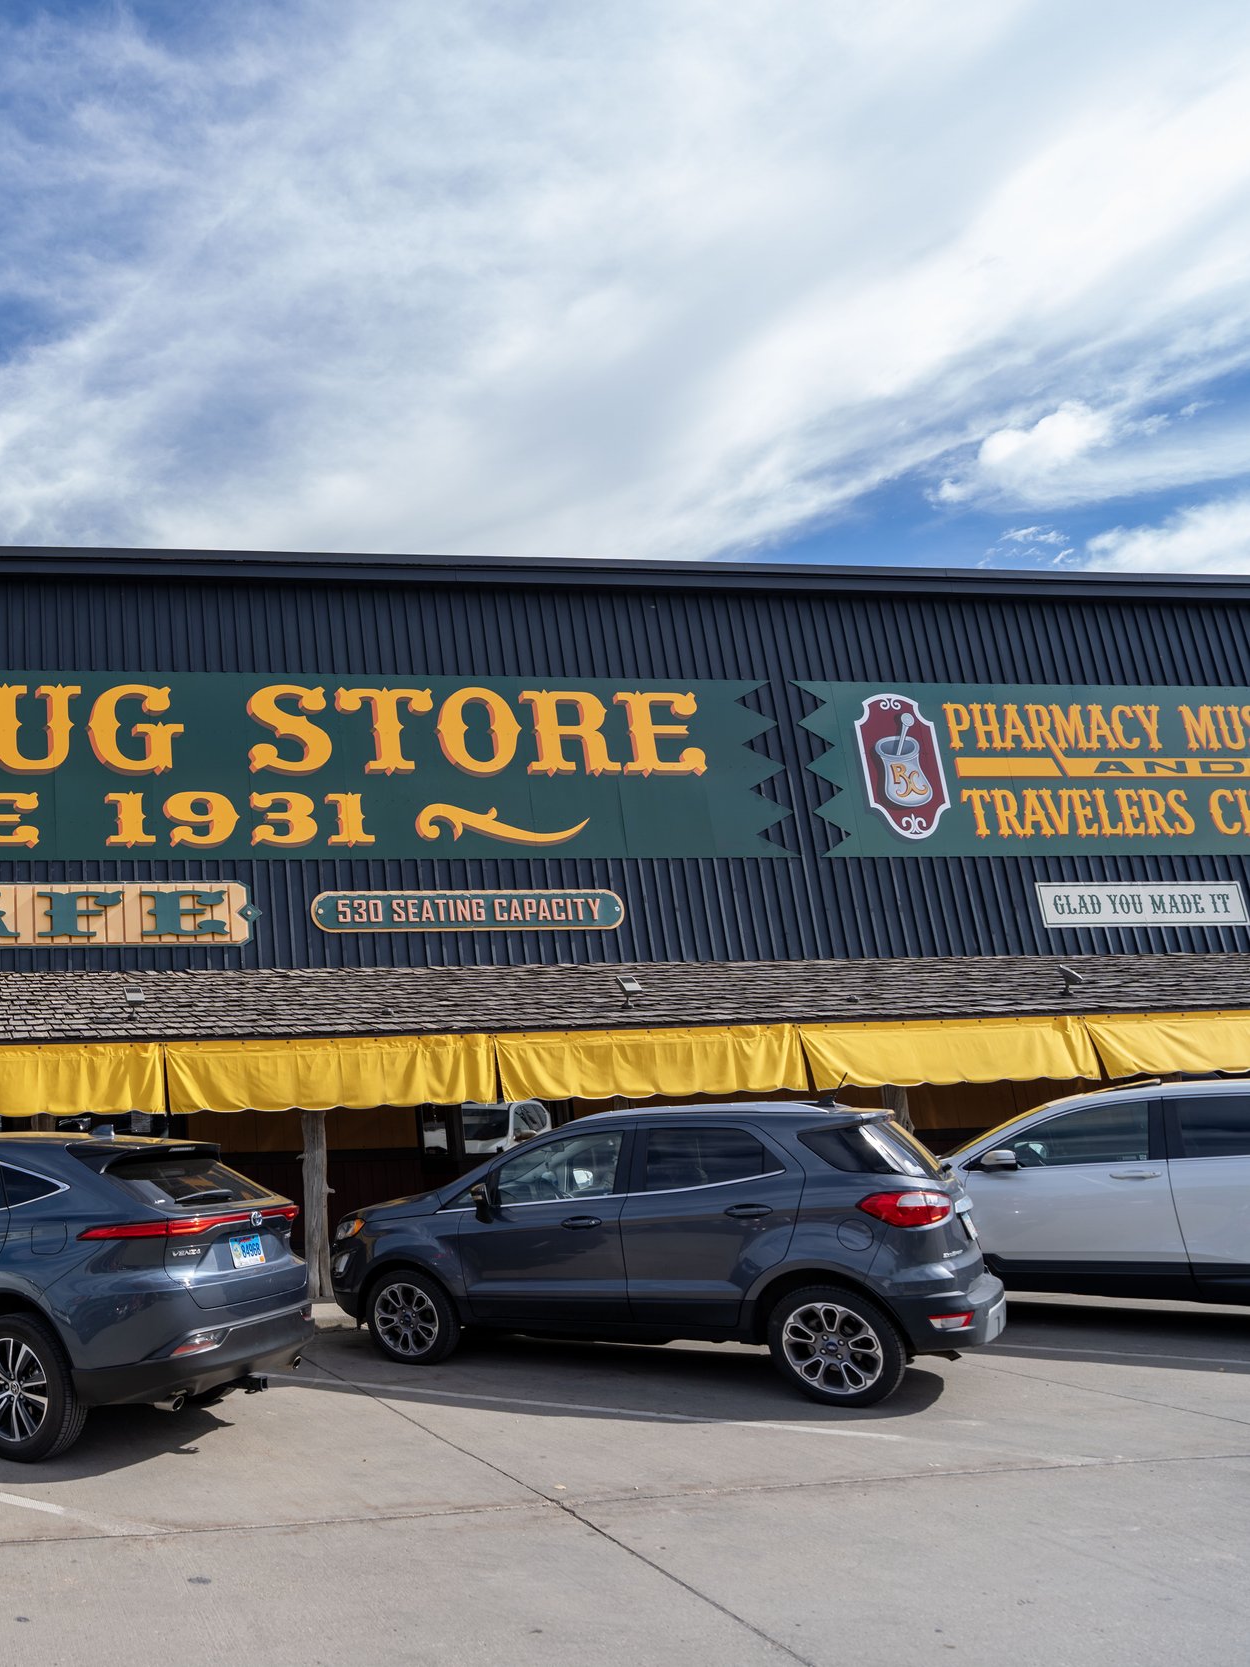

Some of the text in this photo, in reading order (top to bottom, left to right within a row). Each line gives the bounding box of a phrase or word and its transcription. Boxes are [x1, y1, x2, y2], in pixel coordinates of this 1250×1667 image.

[247, 685, 708, 777] STORE
[942, 703, 1162, 752] PHARMACY
[1094, 760, 1245, 774] AND
[105, 791, 376, 849] 1931
[961, 787, 1196, 838] TRAVELERS
[337, 898, 601, 923] 530 SEATING CAPACITY
[1052, 893, 1231, 915] GLAD YOU MADE IT
